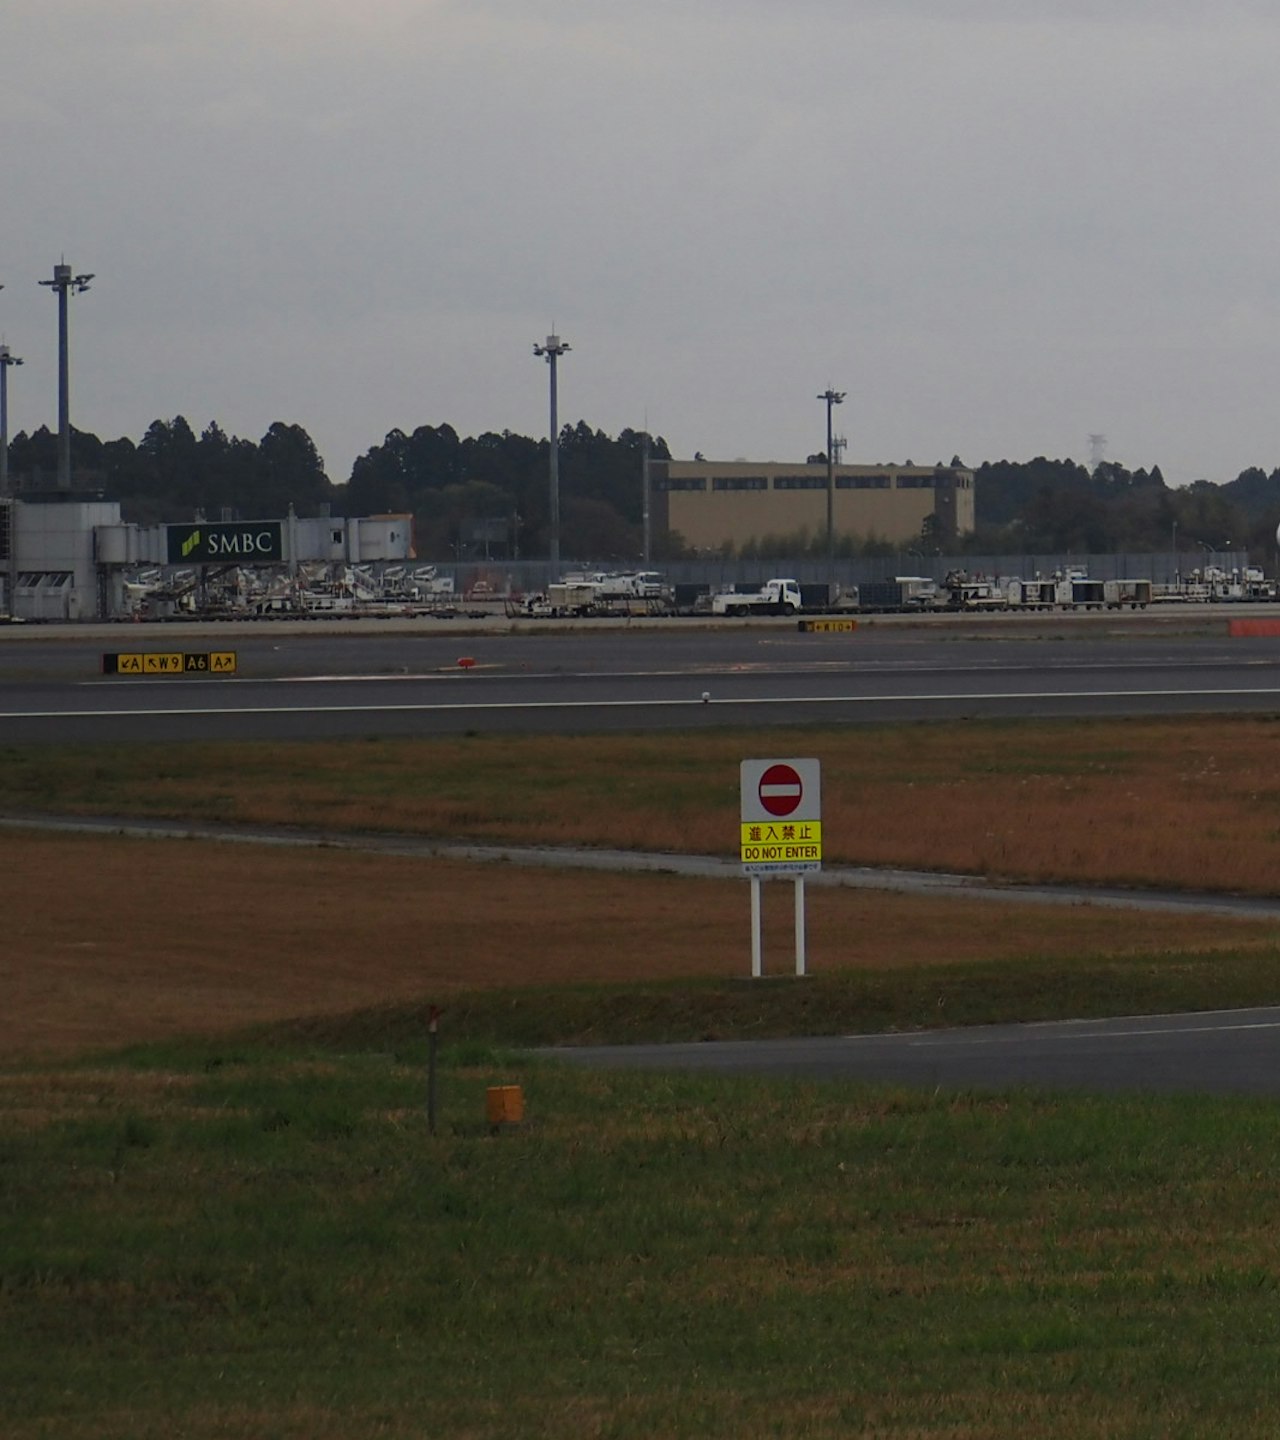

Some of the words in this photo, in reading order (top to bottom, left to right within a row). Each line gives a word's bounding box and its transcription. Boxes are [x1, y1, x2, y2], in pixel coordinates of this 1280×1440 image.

[208, 532, 273, 554] SMBC
[131, 658, 139, 670] A
[187, 656, 206, 669] A6
[214, 657, 223, 669] A
[749, 825, 812, 841] 進入禁止
[745, 847, 760, 859] DO
[762, 846, 782, 859] NOT
[786, 846, 818, 858] ENTER
